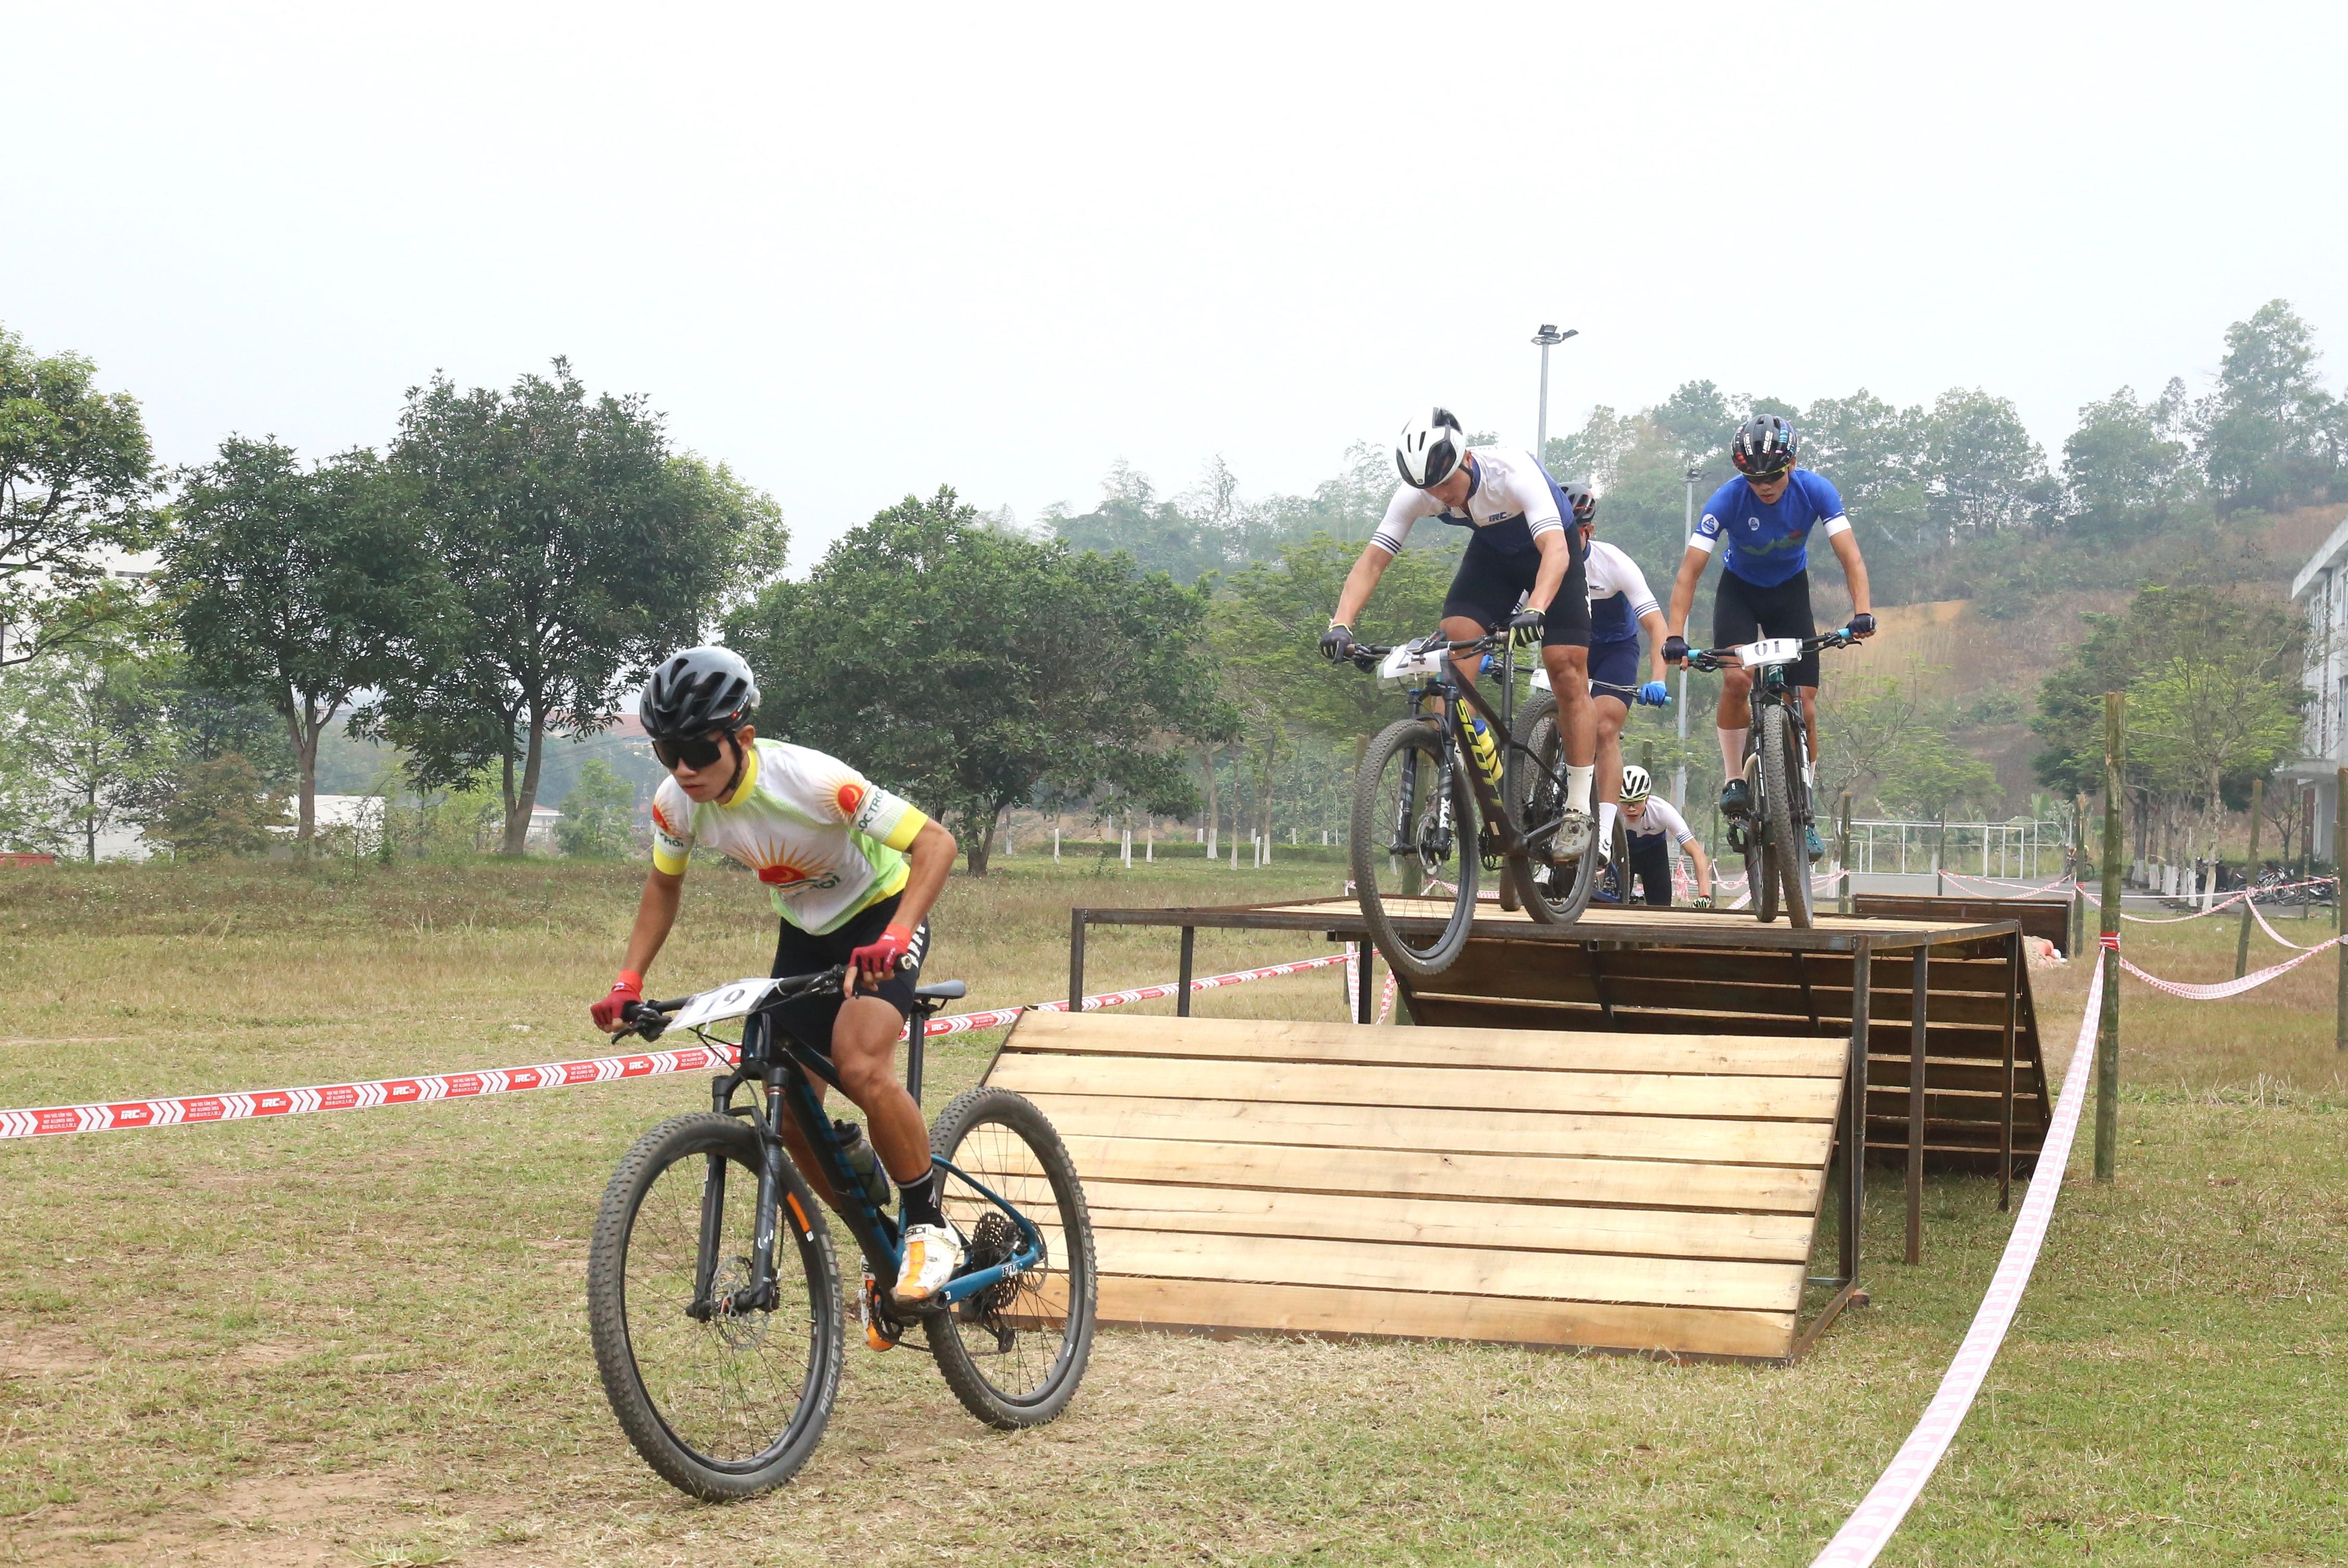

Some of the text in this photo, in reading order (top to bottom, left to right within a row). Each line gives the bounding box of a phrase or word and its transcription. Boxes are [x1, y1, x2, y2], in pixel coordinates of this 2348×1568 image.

[1754, 641, 1781, 656] 01
[1456, 699, 1504, 806] SCOTT
[868, 791, 884, 812] TRO
[820, 1339, 841, 1417] ROCKET
